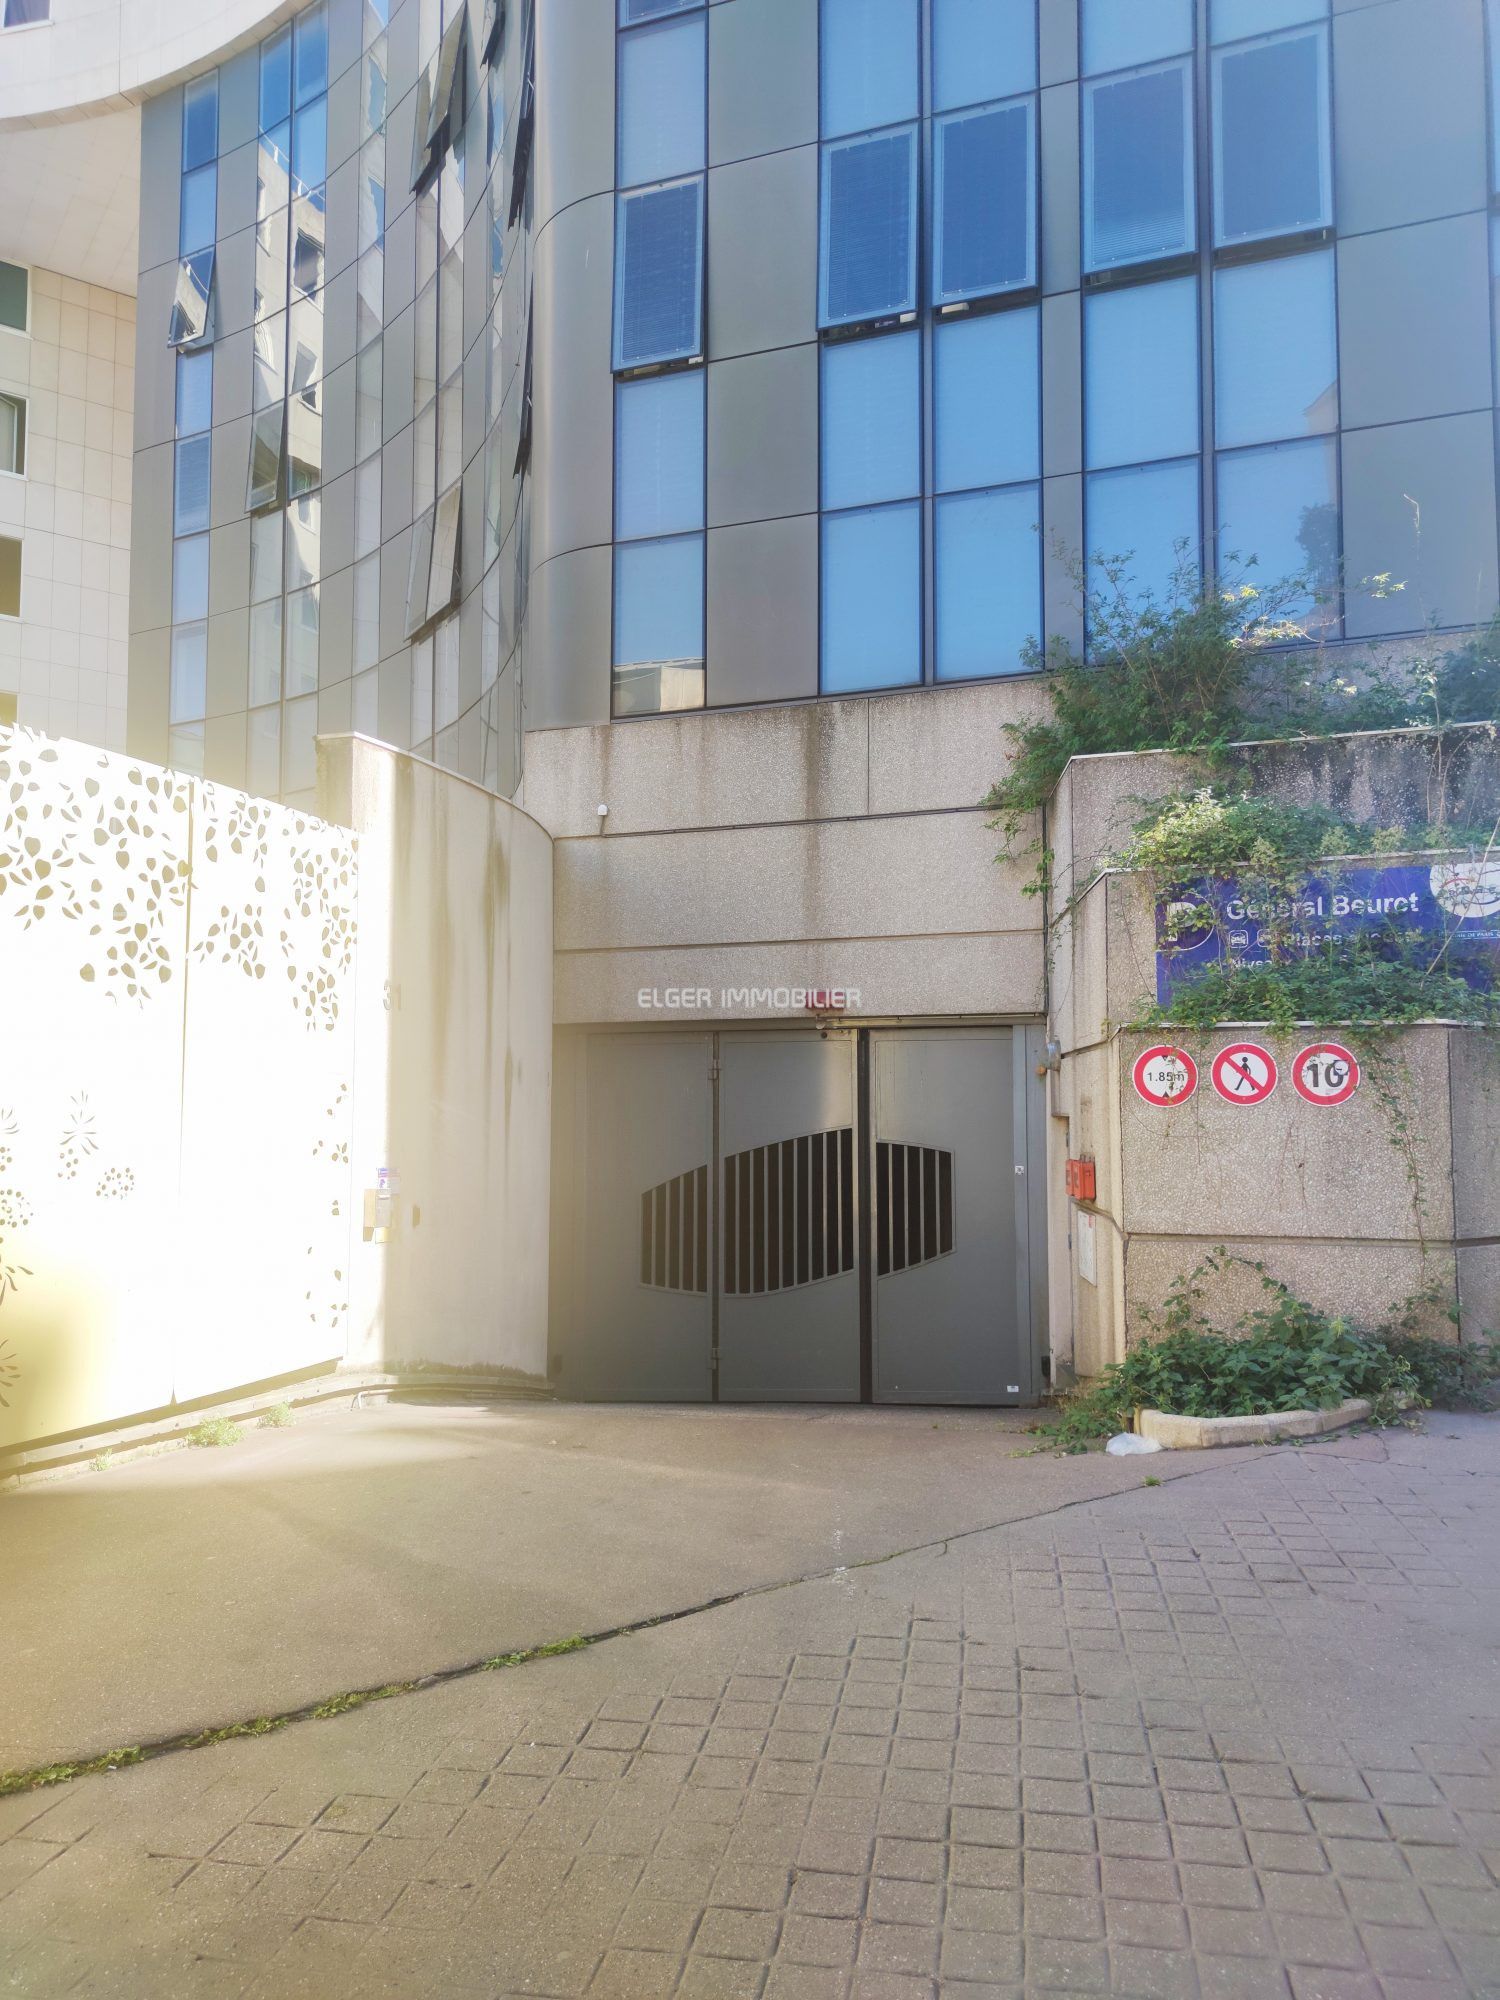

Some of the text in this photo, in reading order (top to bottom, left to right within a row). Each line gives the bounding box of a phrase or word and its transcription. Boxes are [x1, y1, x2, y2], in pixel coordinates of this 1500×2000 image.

[1333, 891, 1419, 916] Beuret
[1147, 1071, 1185, 1082] 1.85m
[1306, 1063, 1344, 1088] 10
